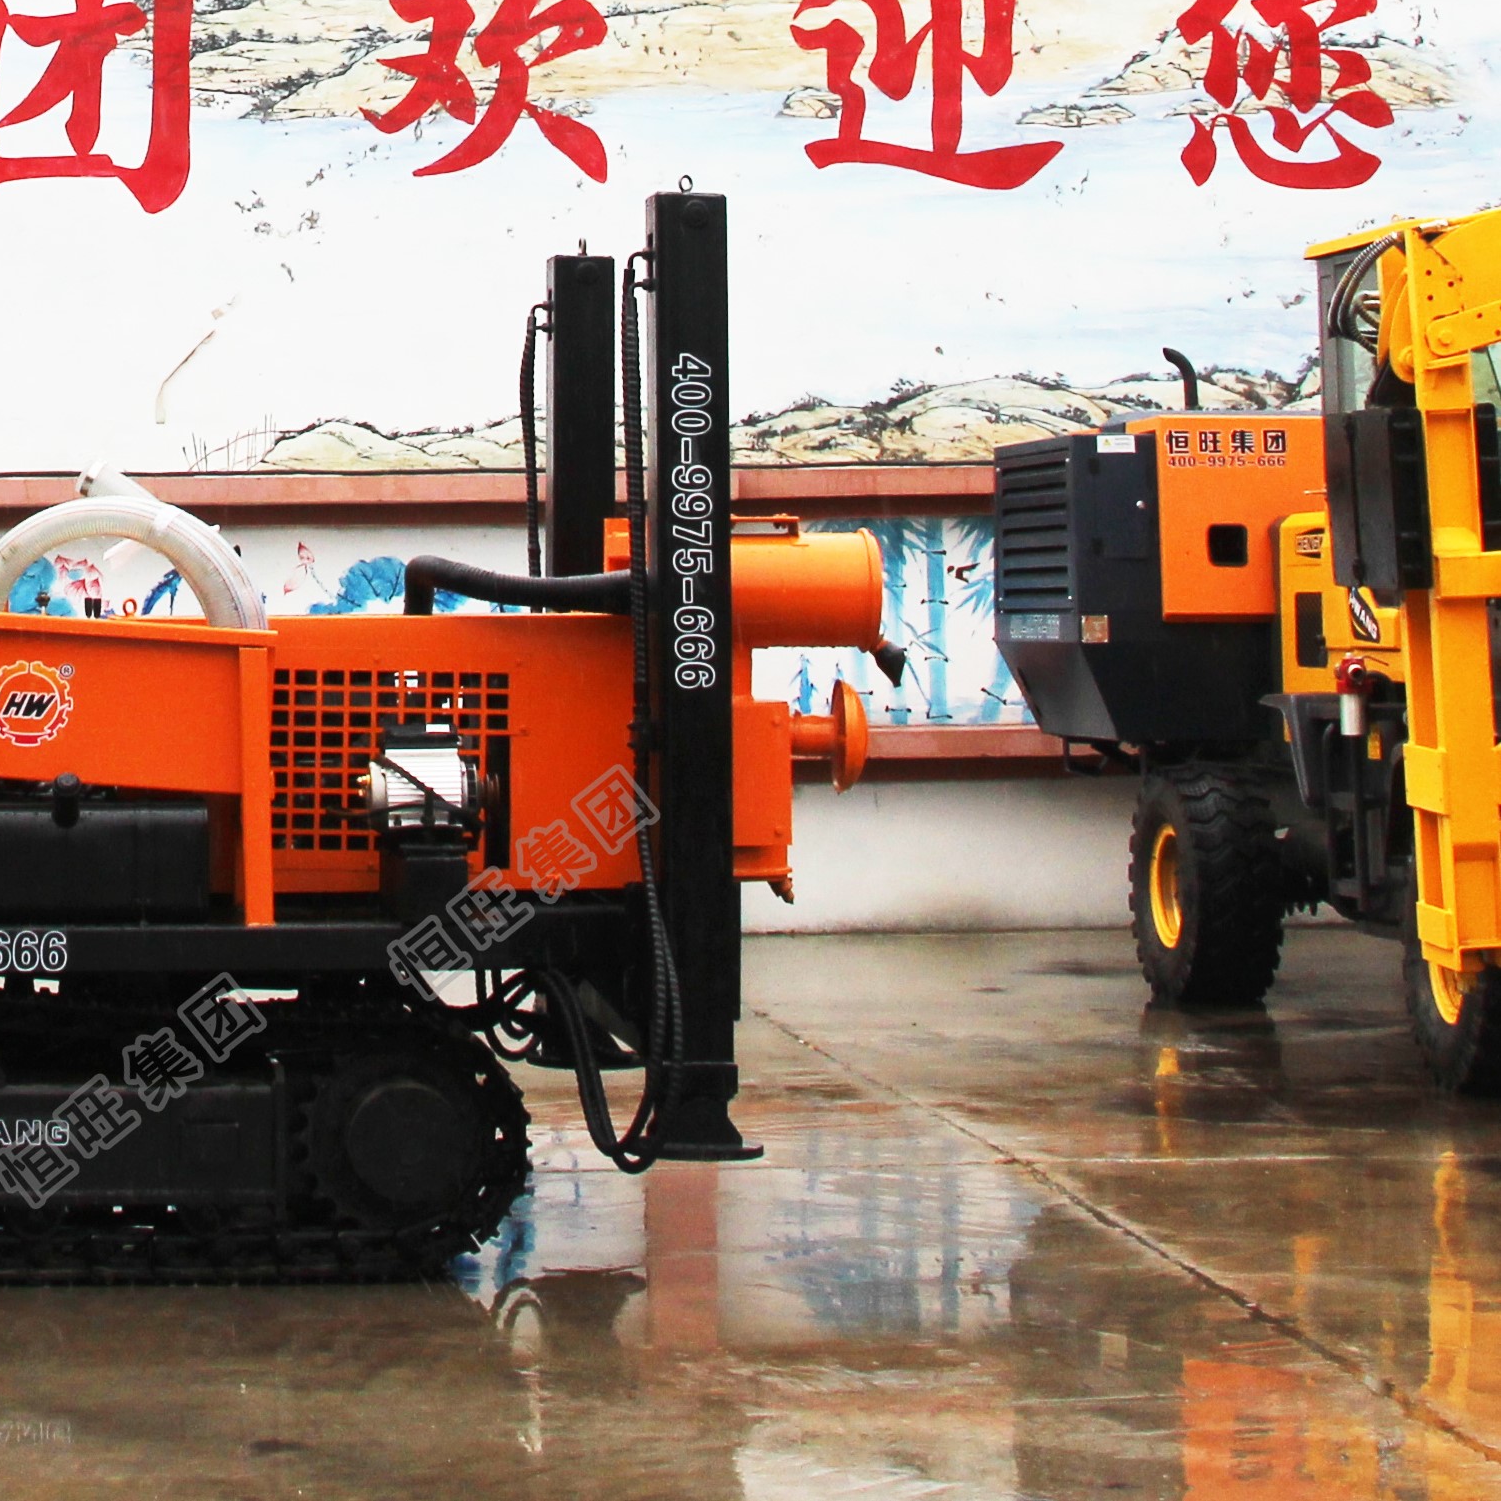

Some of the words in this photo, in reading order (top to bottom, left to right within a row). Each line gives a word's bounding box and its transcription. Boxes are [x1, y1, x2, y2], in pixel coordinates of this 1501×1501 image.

[1166, 429, 1287, 454] 恒旺集团
[1168, 456, 1286, 467] 400-9975-666
[671, 353, 715, 689] 400-9975-666
[1, 691, 57, 719] HW
